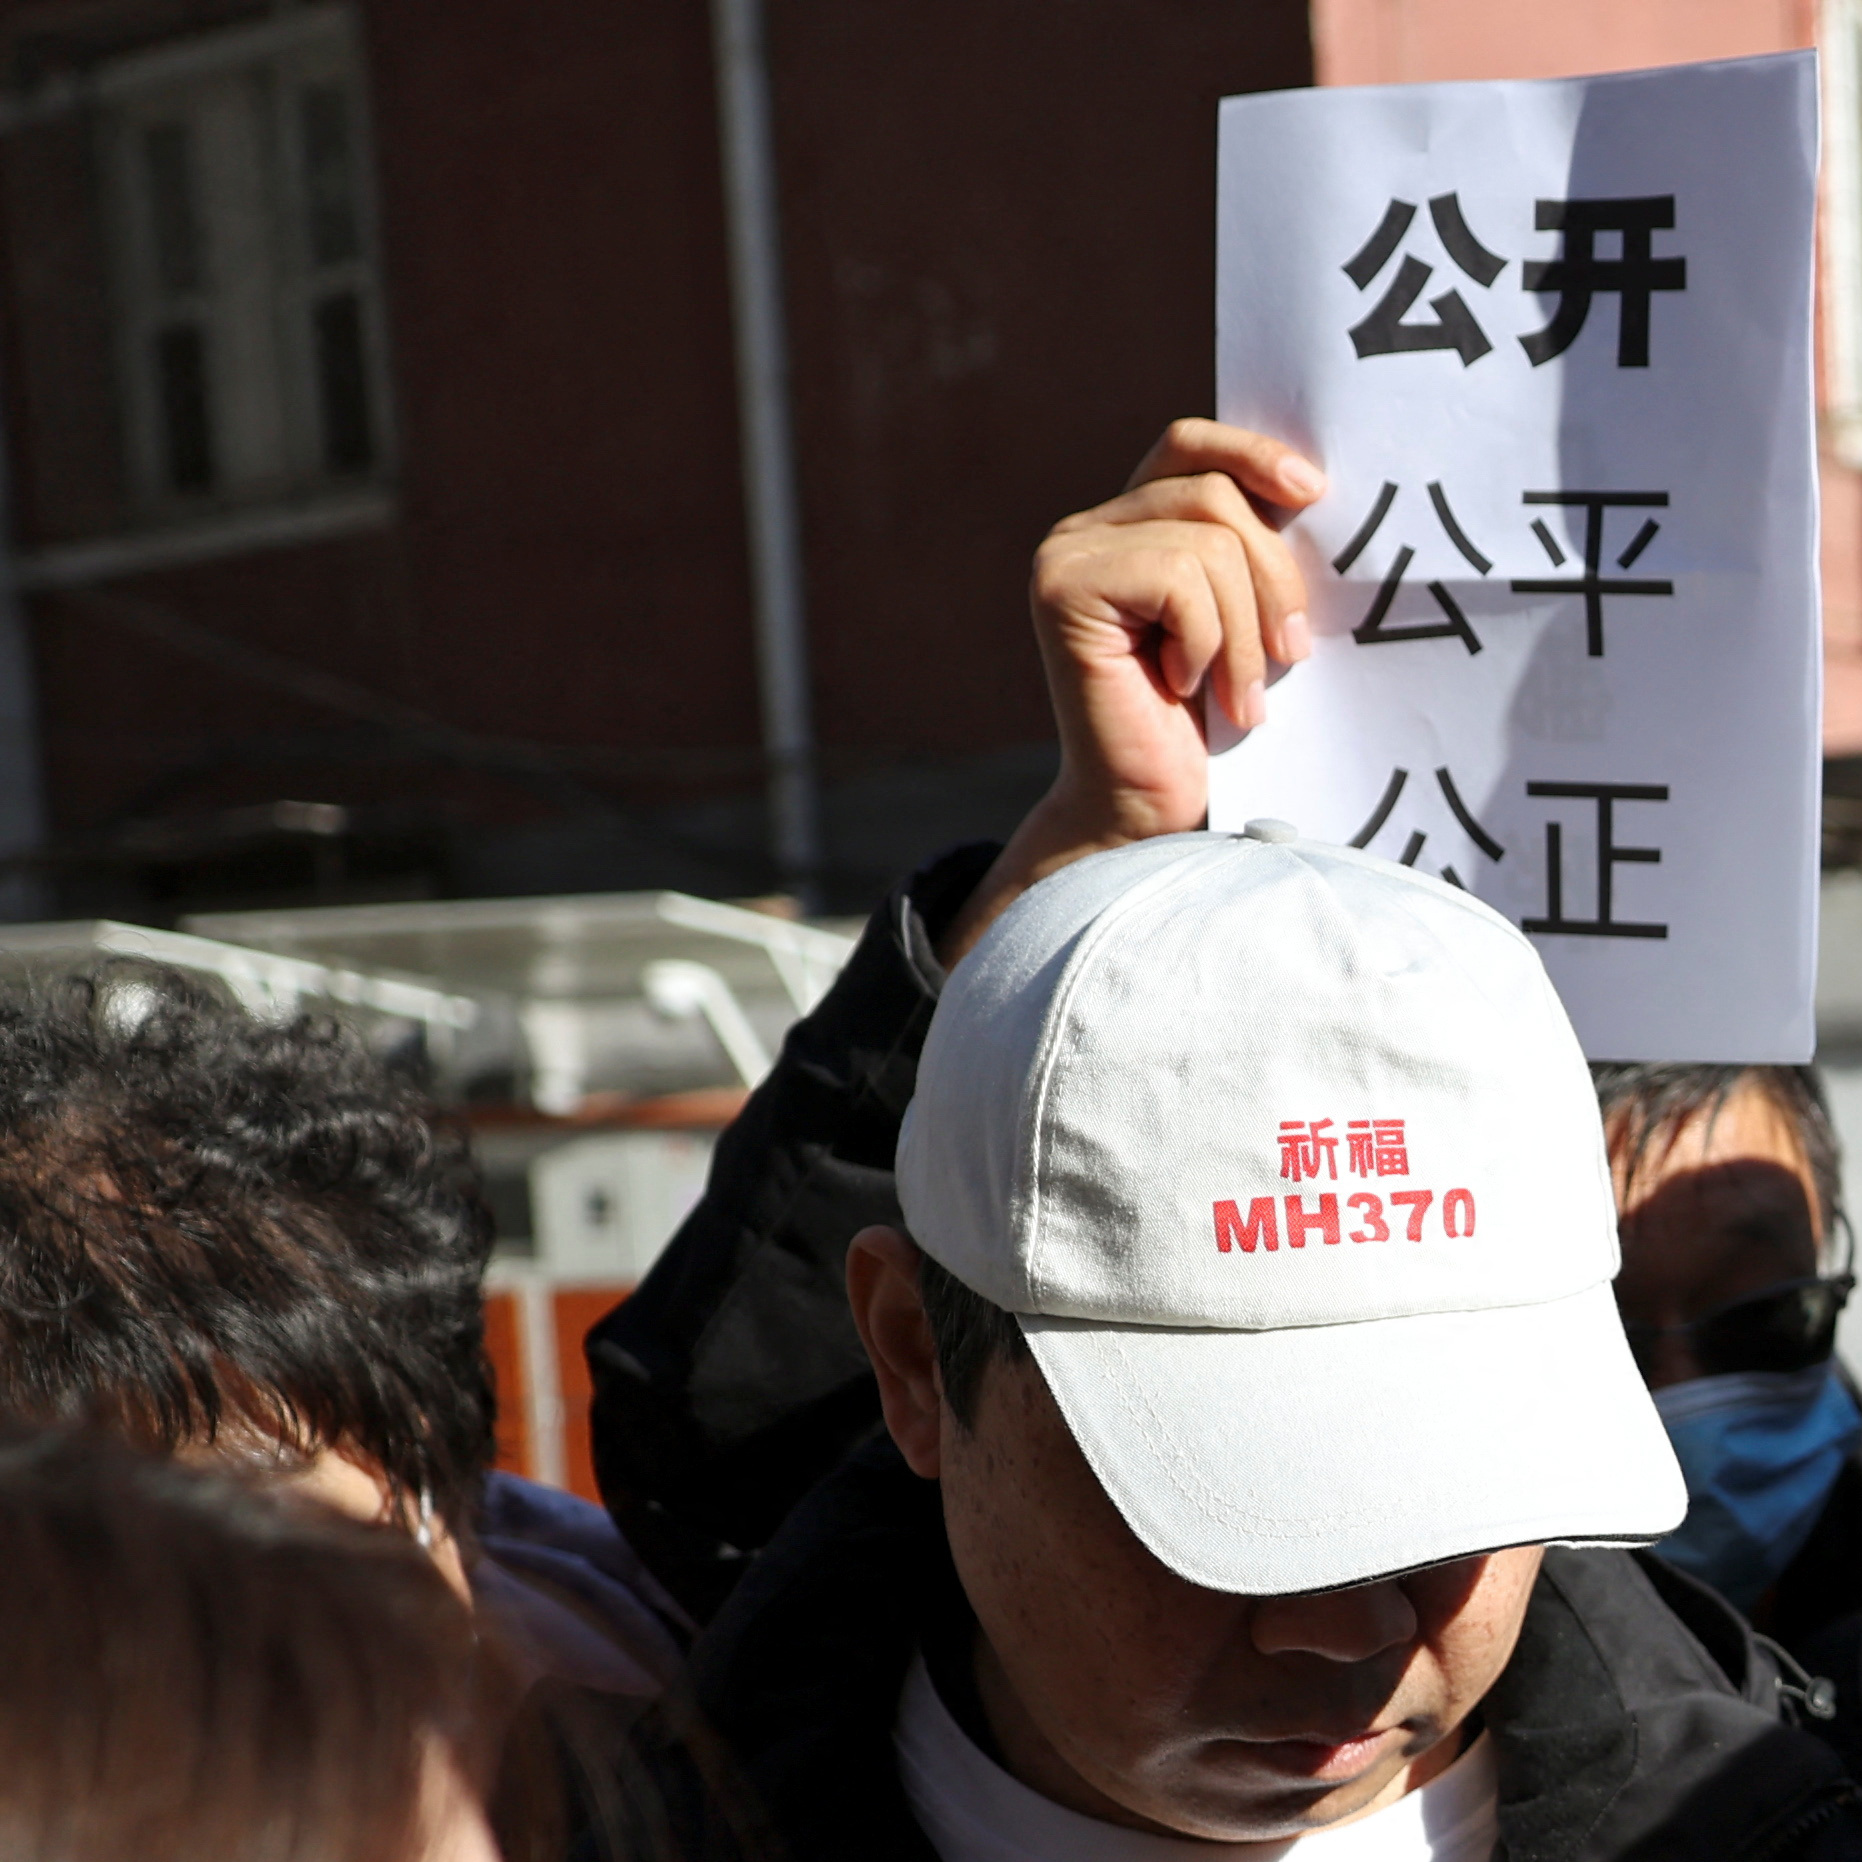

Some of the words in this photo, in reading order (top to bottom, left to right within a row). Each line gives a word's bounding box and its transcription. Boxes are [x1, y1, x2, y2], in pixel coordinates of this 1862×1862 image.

[1341, 191, 1687, 368] 公开
[1333, 481, 1674, 658] 公平
[1277, 1118, 1410, 1183] 祈福
[1212, 1188, 1476, 1254] MH370
